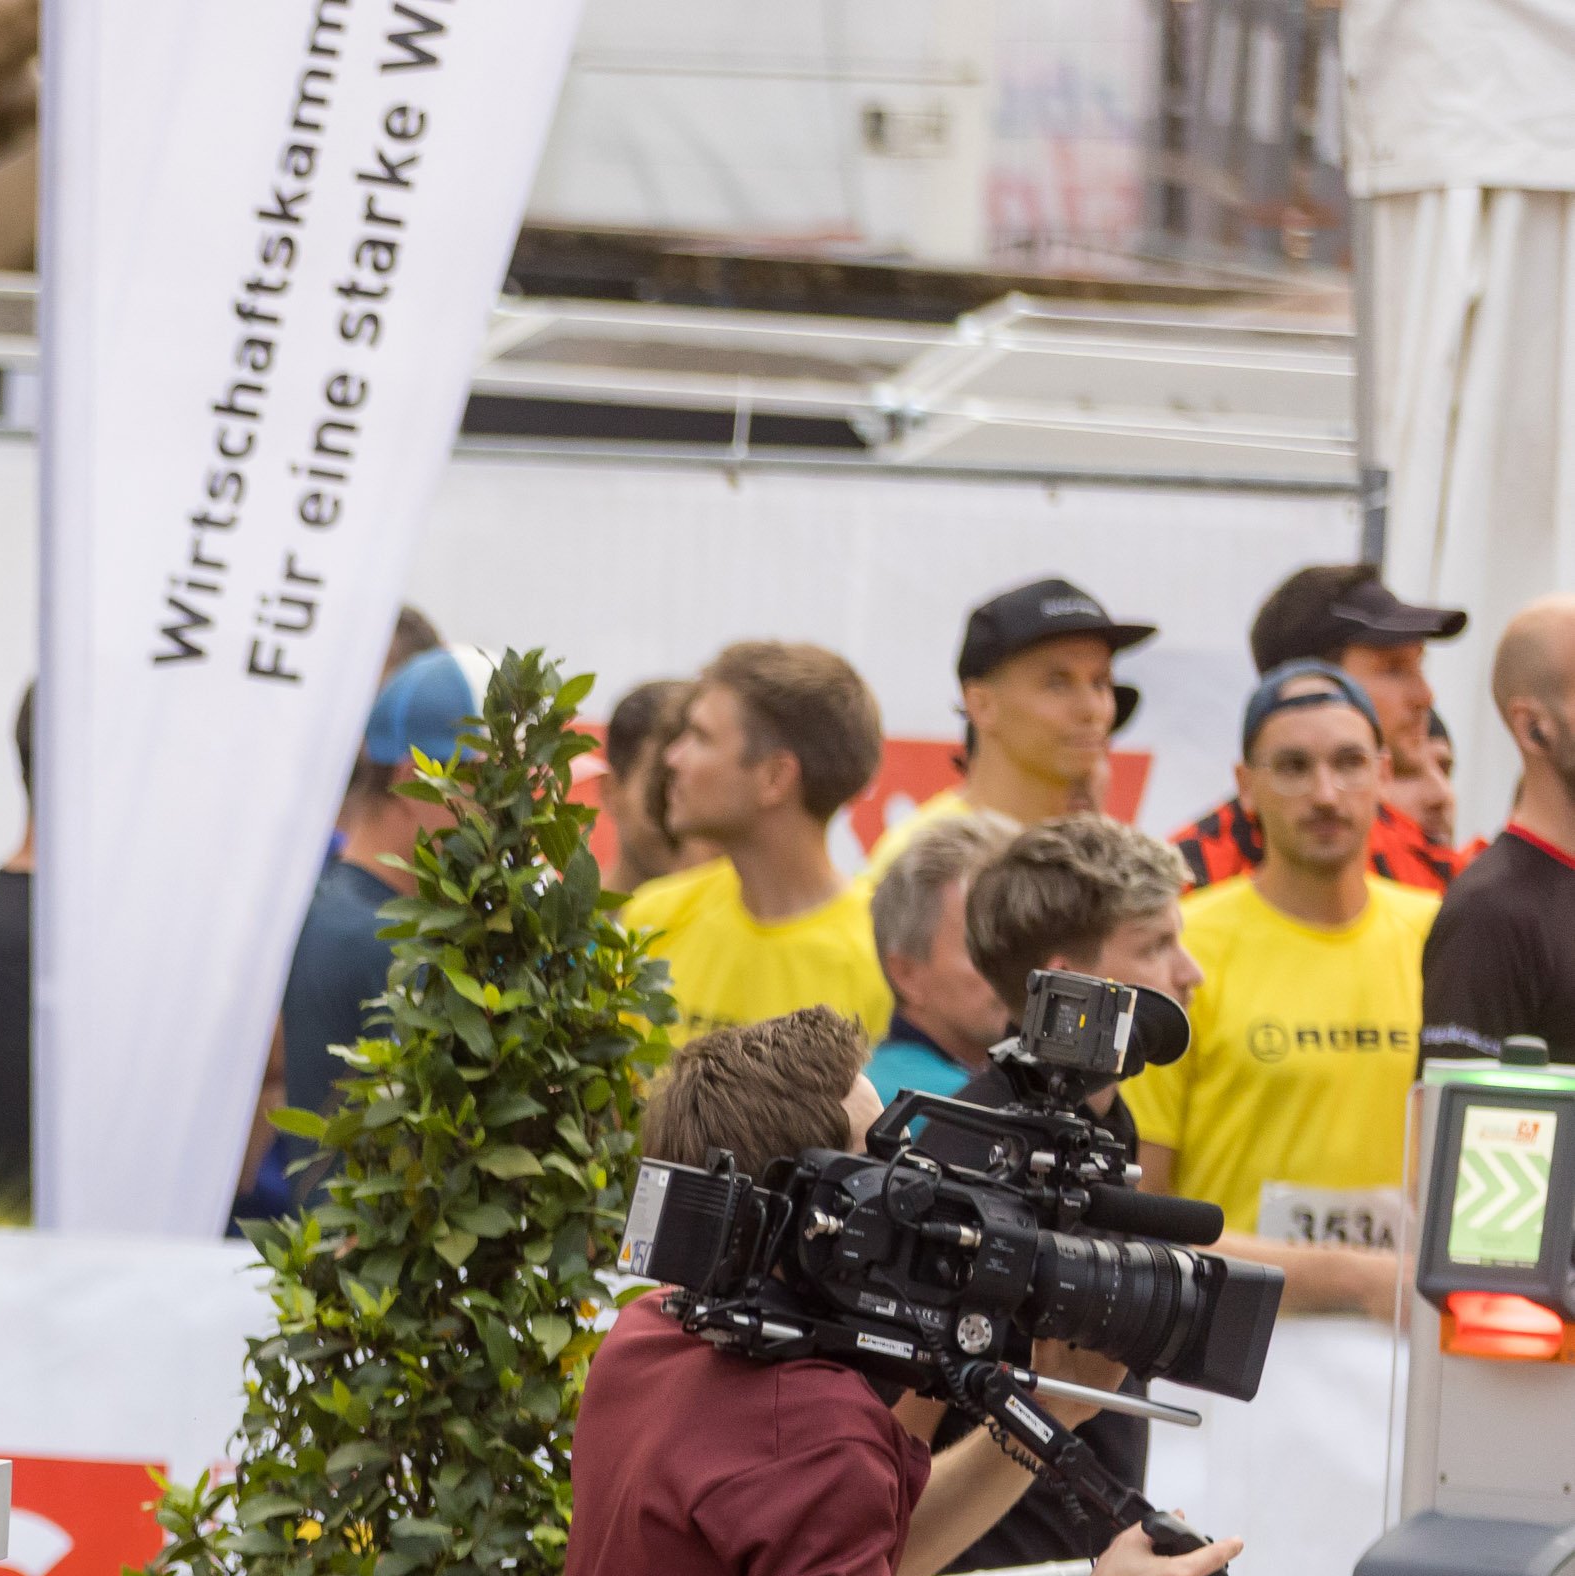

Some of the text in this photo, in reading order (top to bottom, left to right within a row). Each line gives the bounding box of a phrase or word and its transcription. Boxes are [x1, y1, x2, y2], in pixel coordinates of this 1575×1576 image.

[150, 0, 349, 668] Wirtschaftskamm
[245, 0, 451, 684] Für eine starke W
